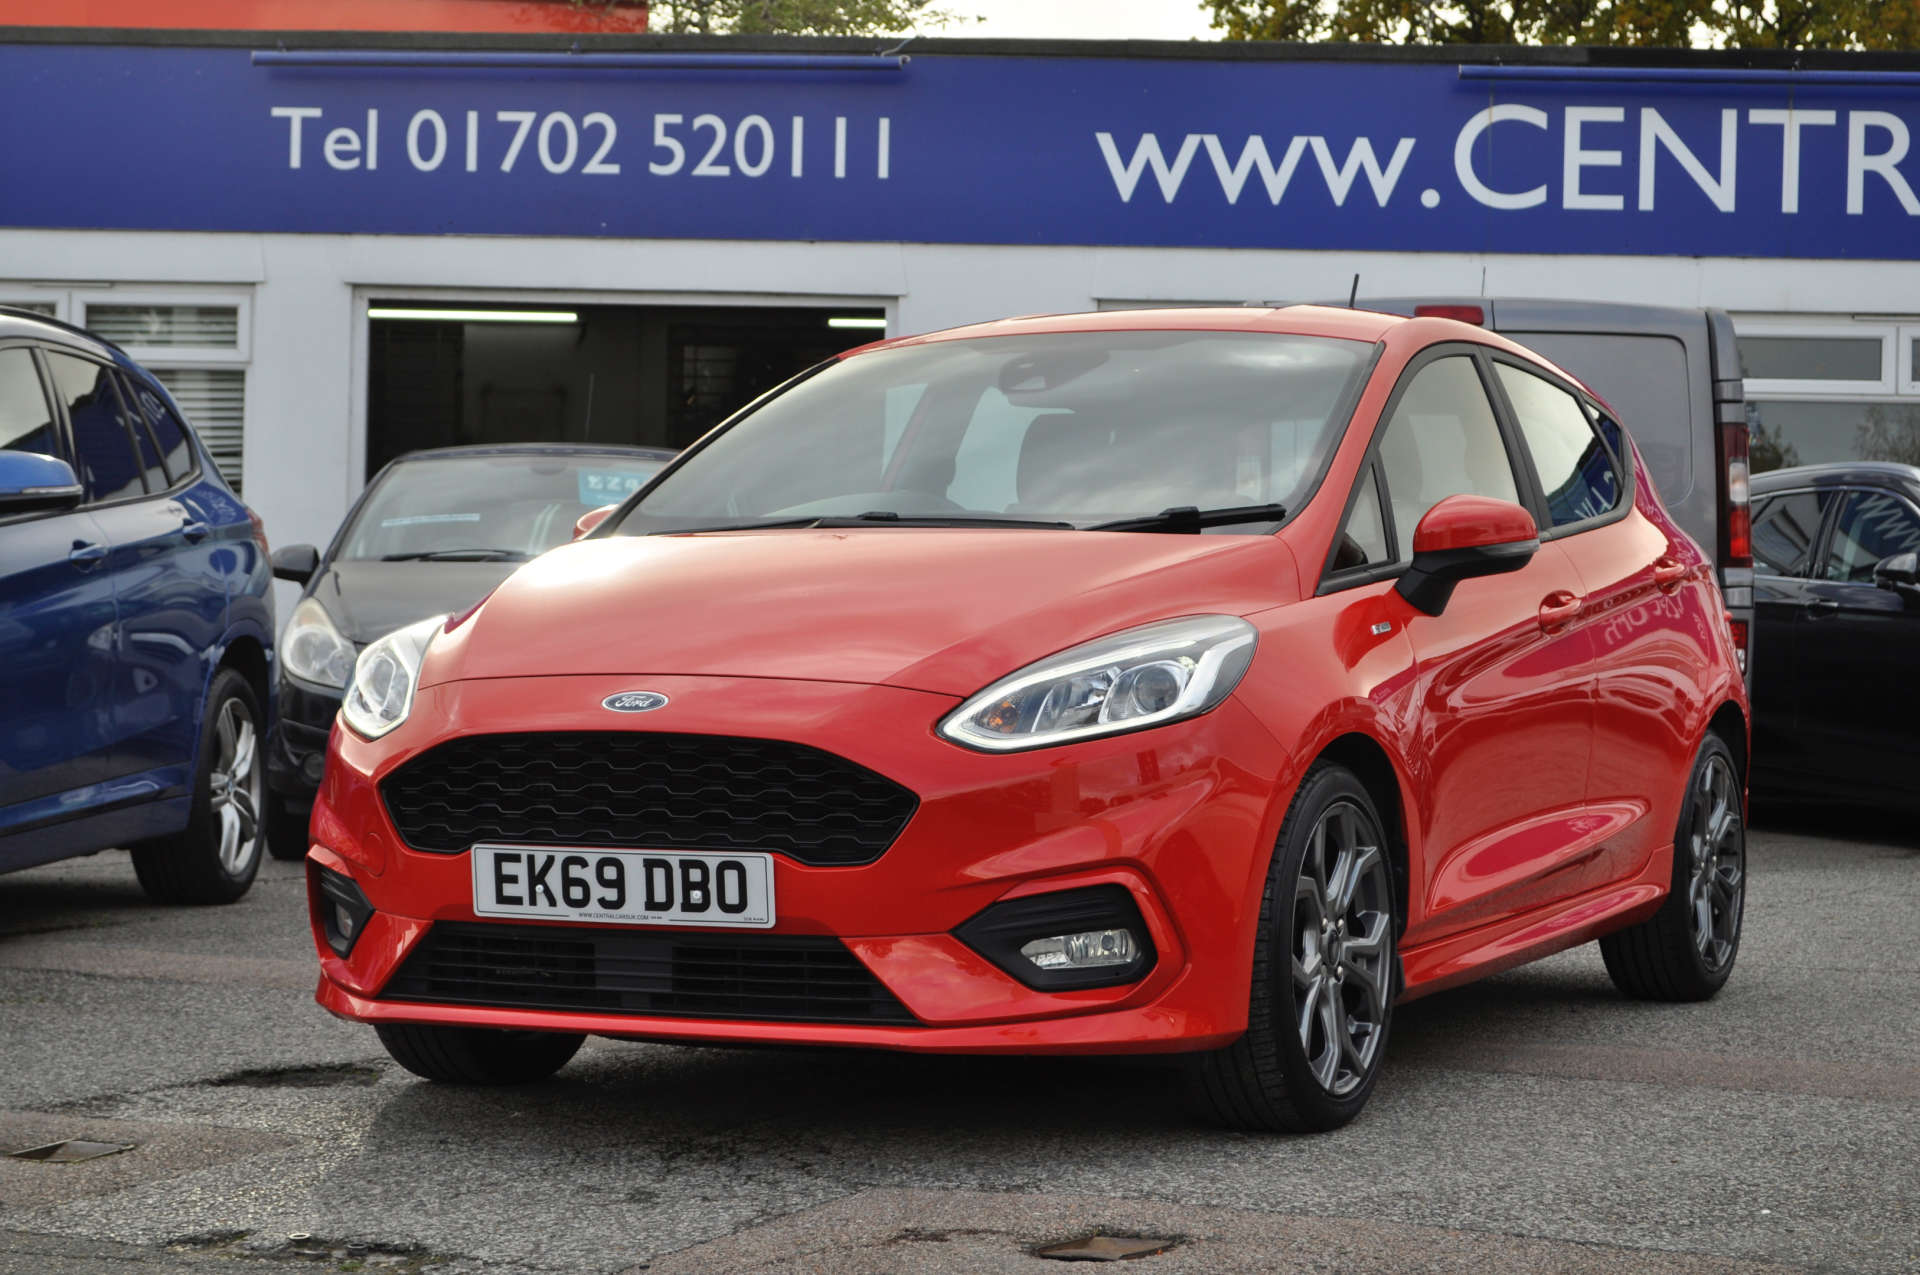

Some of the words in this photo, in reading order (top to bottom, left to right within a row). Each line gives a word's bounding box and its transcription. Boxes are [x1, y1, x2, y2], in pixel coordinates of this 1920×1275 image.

[270, 106, 378, 170] Tel
[406, 109, 621, 175] 01702
[648, 113, 890, 179] 520111
[615, 695, 654, 707] Ford
[493, 852, 626, 910] EK69
[642, 857, 748, 914] DBO
